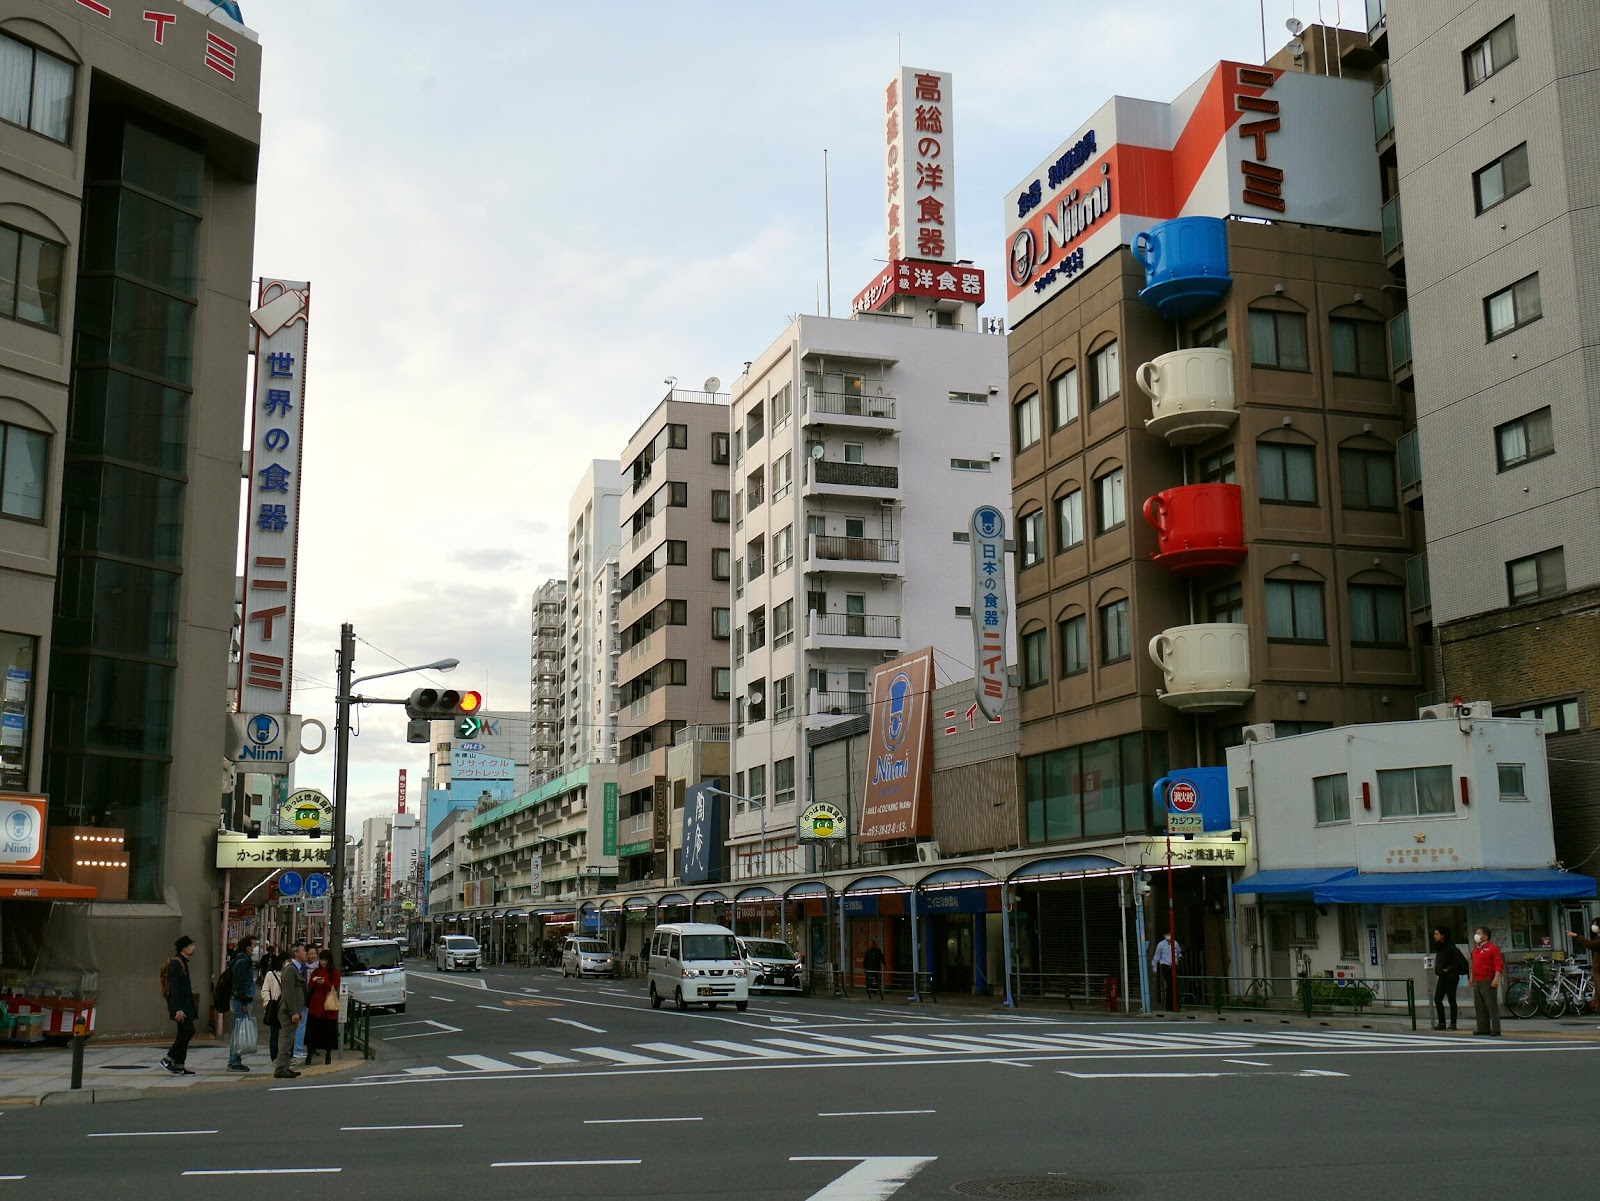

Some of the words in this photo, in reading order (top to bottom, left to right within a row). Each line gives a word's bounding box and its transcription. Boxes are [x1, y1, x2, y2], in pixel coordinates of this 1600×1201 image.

[913, 72, 945, 257] 高総の洋食器
[1037, 162, 1111, 265] Niimi
[914, 267, 982, 295] 洋食器
[256, 351, 295, 533] 世界の食器
[982, 544, 999, 626] 日本の食器
[246, 556, 288, 691] ニイミ
[983, 632, 1003, 699] ニイミ
[239, 744, 284, 761] Niimi
[456, 759, 509, 767] リサイクル
[456, 769, 509, 777] アウトレット
[872, 749, 909, 785] Niimi
[1173, 791, 1194, 803] 消火栓
[1169, 816, 1202, 825] カジワラ
[3, 842, 32, 854] Niimi
[13, 888, 32, 897] Niimi
[309, 880, 319, 895] P
